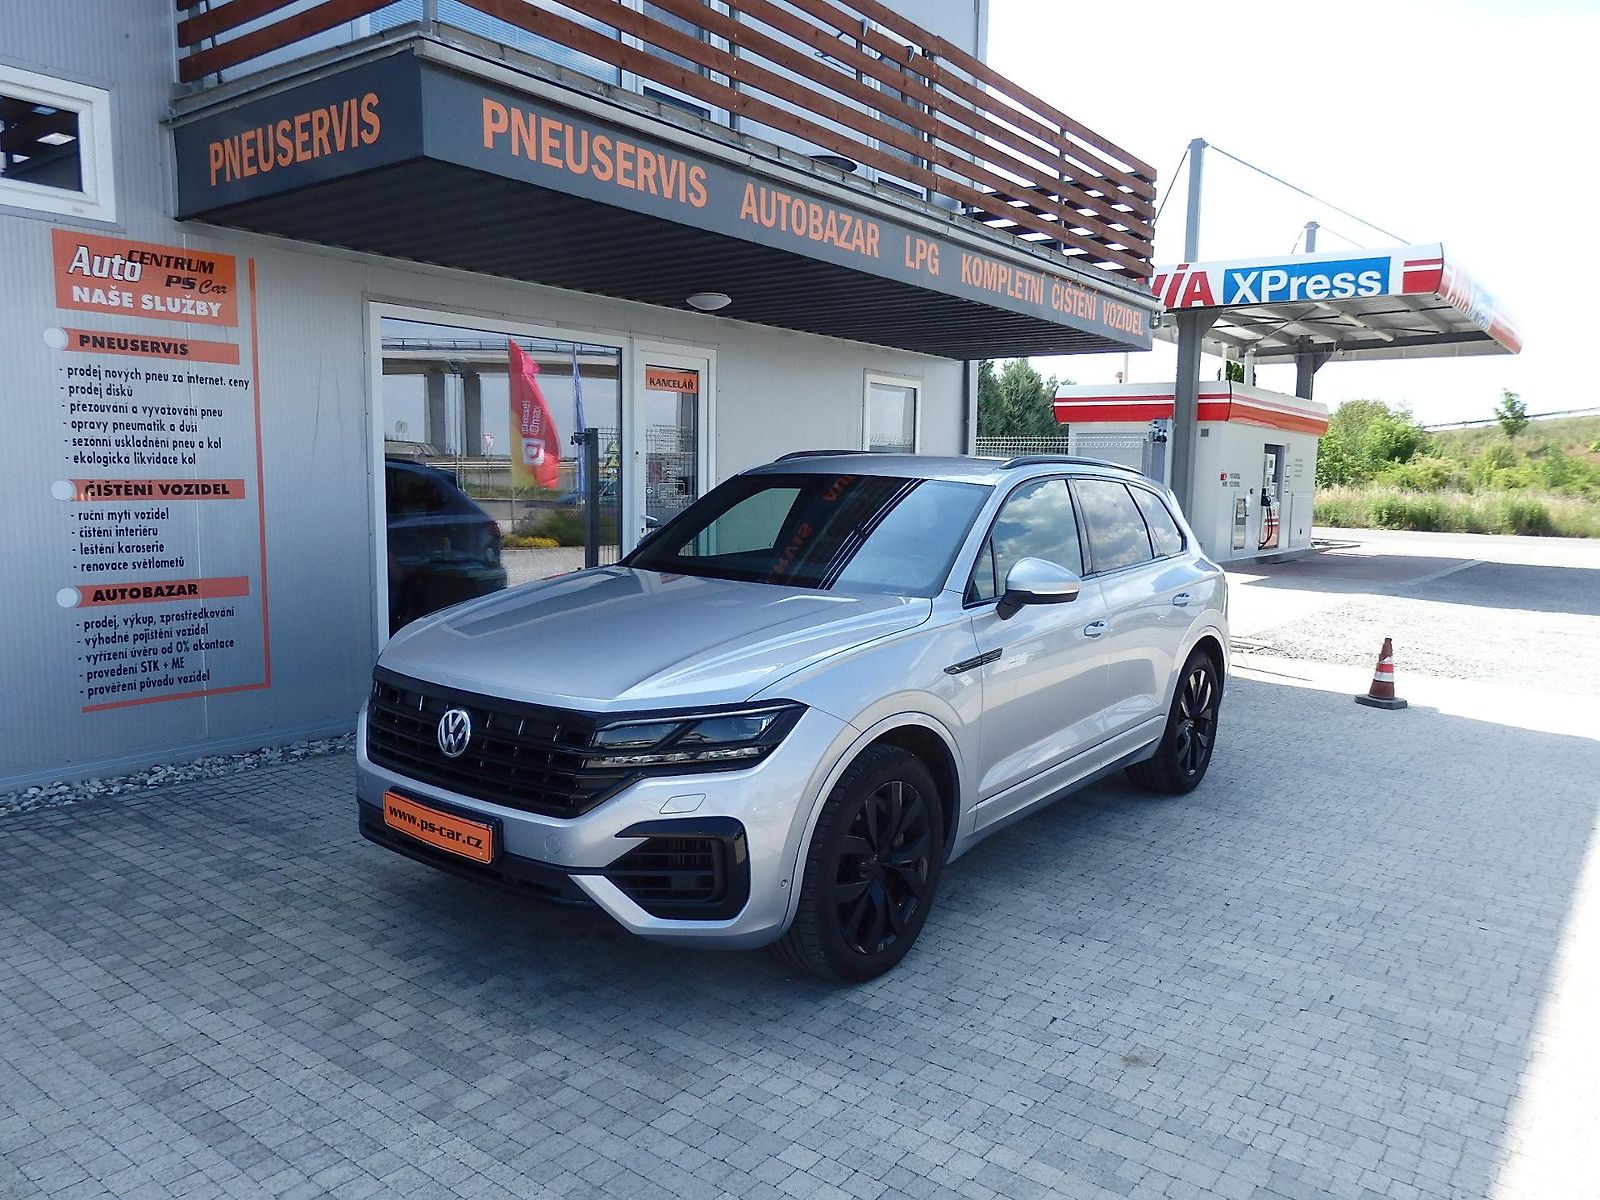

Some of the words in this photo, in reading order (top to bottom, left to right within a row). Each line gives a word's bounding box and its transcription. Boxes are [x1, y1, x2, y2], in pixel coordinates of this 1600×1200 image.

[208, 92, 381, 187] PNEUSERVIS
[482, 97, 708, 208] PNEUSERVIS
[740, 182, 880, 258] AUTOBAZAR
[904, 234, 939, 276] LPG
[961, 253, 1047, 305] KOMPLETNÍ
[1051, 275, 1099, 321] ČIŠTĚNÍ
[1102, 300, 1144, 337] VOZIDEL
[67, 244, 144, 283] Auto
[127, 249, 215, 274] CENTRUM
[165, 275, 197, 290] PS
[198, 279, 229, 295] Car
[1231, 268, 1384, 305] XPress
[72, 286, 134, 308] NAŠE
[141, 294, 222, 318] SLUŽBY
[79, 334, 190, 356] PNEUSERVIS
[67, 364, 102, 381] prodej
[105, 367, 142, 383] nových
[145, 372, 169, 384] pneu
[172, 373, 184, 383] za
[187, 371, 226, 386] internet.
[228, 378, 250, 391] ceny
[649, 377, 694, 390] KANCELÁŘ
[69, 382, 103, 399] prodej
[106, 383, 133, 397] disků
[70, 401, 128, 415] přezouvání
[131, 405, 138, 414] a
[142, 404, 198, 418] vyvažování
[201, 408, 223, 419] pneu
[71, 420, 109, 434] opravy
[112, 419, 166, 434] pneumatik
[169, 423, 176, 432] a
[179, 419, 198, 433] duší
[72, 435, 112, 447] sezónní
[115, 434, 169, 449] uskladnění
[172, 440, 195, 452] pneu
[198, 440, 204, 449] a
[207, 436, 222, 449] kol
[73, 450, 130, 467] ekologická
[134, 451, 178, 465] likvidace
[181, 452, 196, 465] kol
[85, 481, 153, 497] ČIŠTĚNÍ
[158, 483, 230, 496] VOZIDEL
[78, 509, 104, 521] ruční
[107, 509, 131, 524] mytí
[134, 507, 169, 520] vozidel
[79, 526, 112, 538] čištění
[115, 524, 159, 537] interiéru
[80, 542, 115, 555] leštění
[118, 540, 165, 554] karoserie
[81, 561, 128, 573] renovace
[132, 556, 185, 570] světlometů
[92, 583, 199, 602] AUTOBAZAR
[84, 614, 120, 632] prodej,
[123, 613, 157, 629] výkup,
[160, 606, 235, 625] zprostředkování
[85, 631, 130, 648] výhodné
[133, 628, 173, 645] pojištění
[176, 622, 209, 637] vozidel
[86, 648, 128, 665] vyřízení
[131, 646, 158, 658] úvěru
[161, 641, 173, 655] od
[176, 641, 190, 653] 0%
[193, 638, 235, 652] akontace
[87, 663, 138, 683] provedení
[141, 659, 160, 673] STK
[172, 656, 185, 670] ME
[88, 679, 137, 699] prověření
[140, 674, 175, 692] původu
[177, 668, 210, 684] vozidel
[388, 805, 483, 850] www.ps-car.cz
